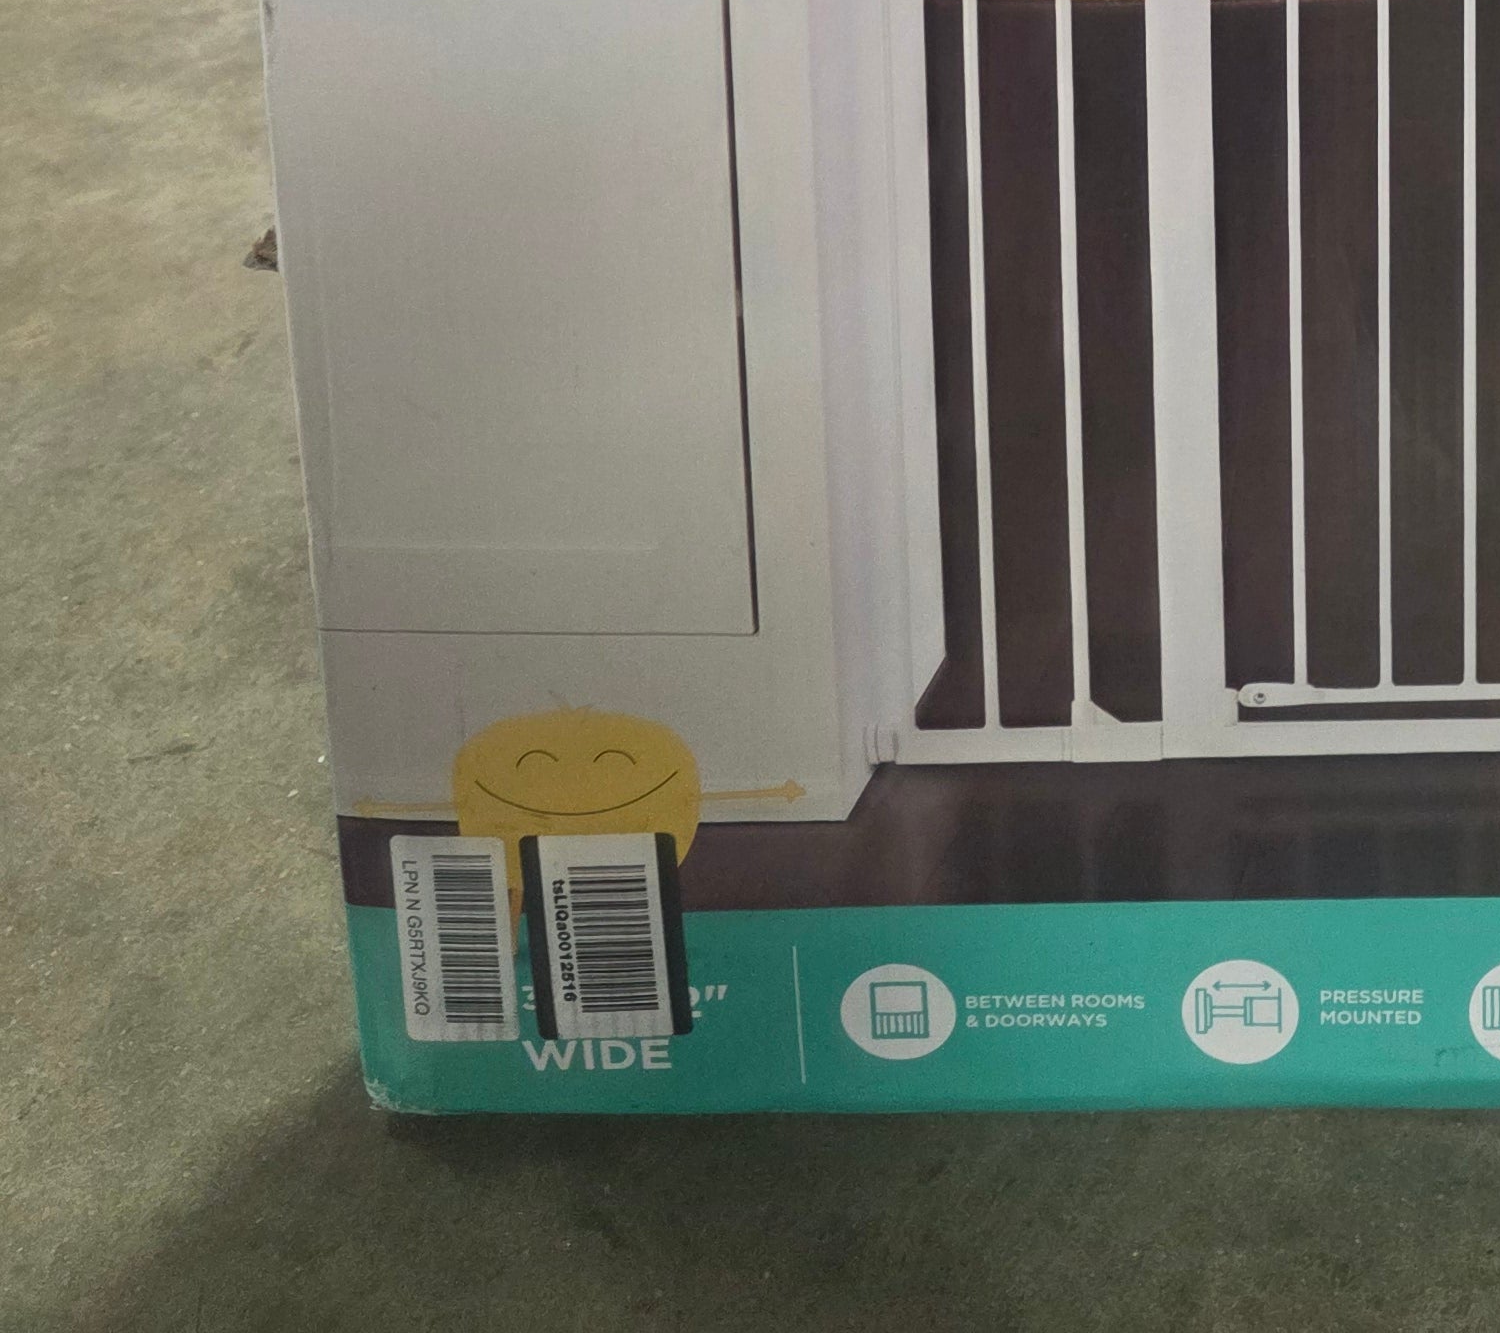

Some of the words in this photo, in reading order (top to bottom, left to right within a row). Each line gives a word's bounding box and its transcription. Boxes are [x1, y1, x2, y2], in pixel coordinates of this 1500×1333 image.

[401, 860, 421, 894] LPN
[965, 994, 1066, 1010] BETWEEN
[1070, 993, 1146, 1010] ROOMS
[1319, 989, 1424, 1005] PRESSURE
[965, 1014, 979, 1028] &
[984, 1013, 1108, 1029] DOORWAYS
[1319, 1010, 1422, 1026] MOUNTED
[521, 1038, 673, 1071] WIDE
